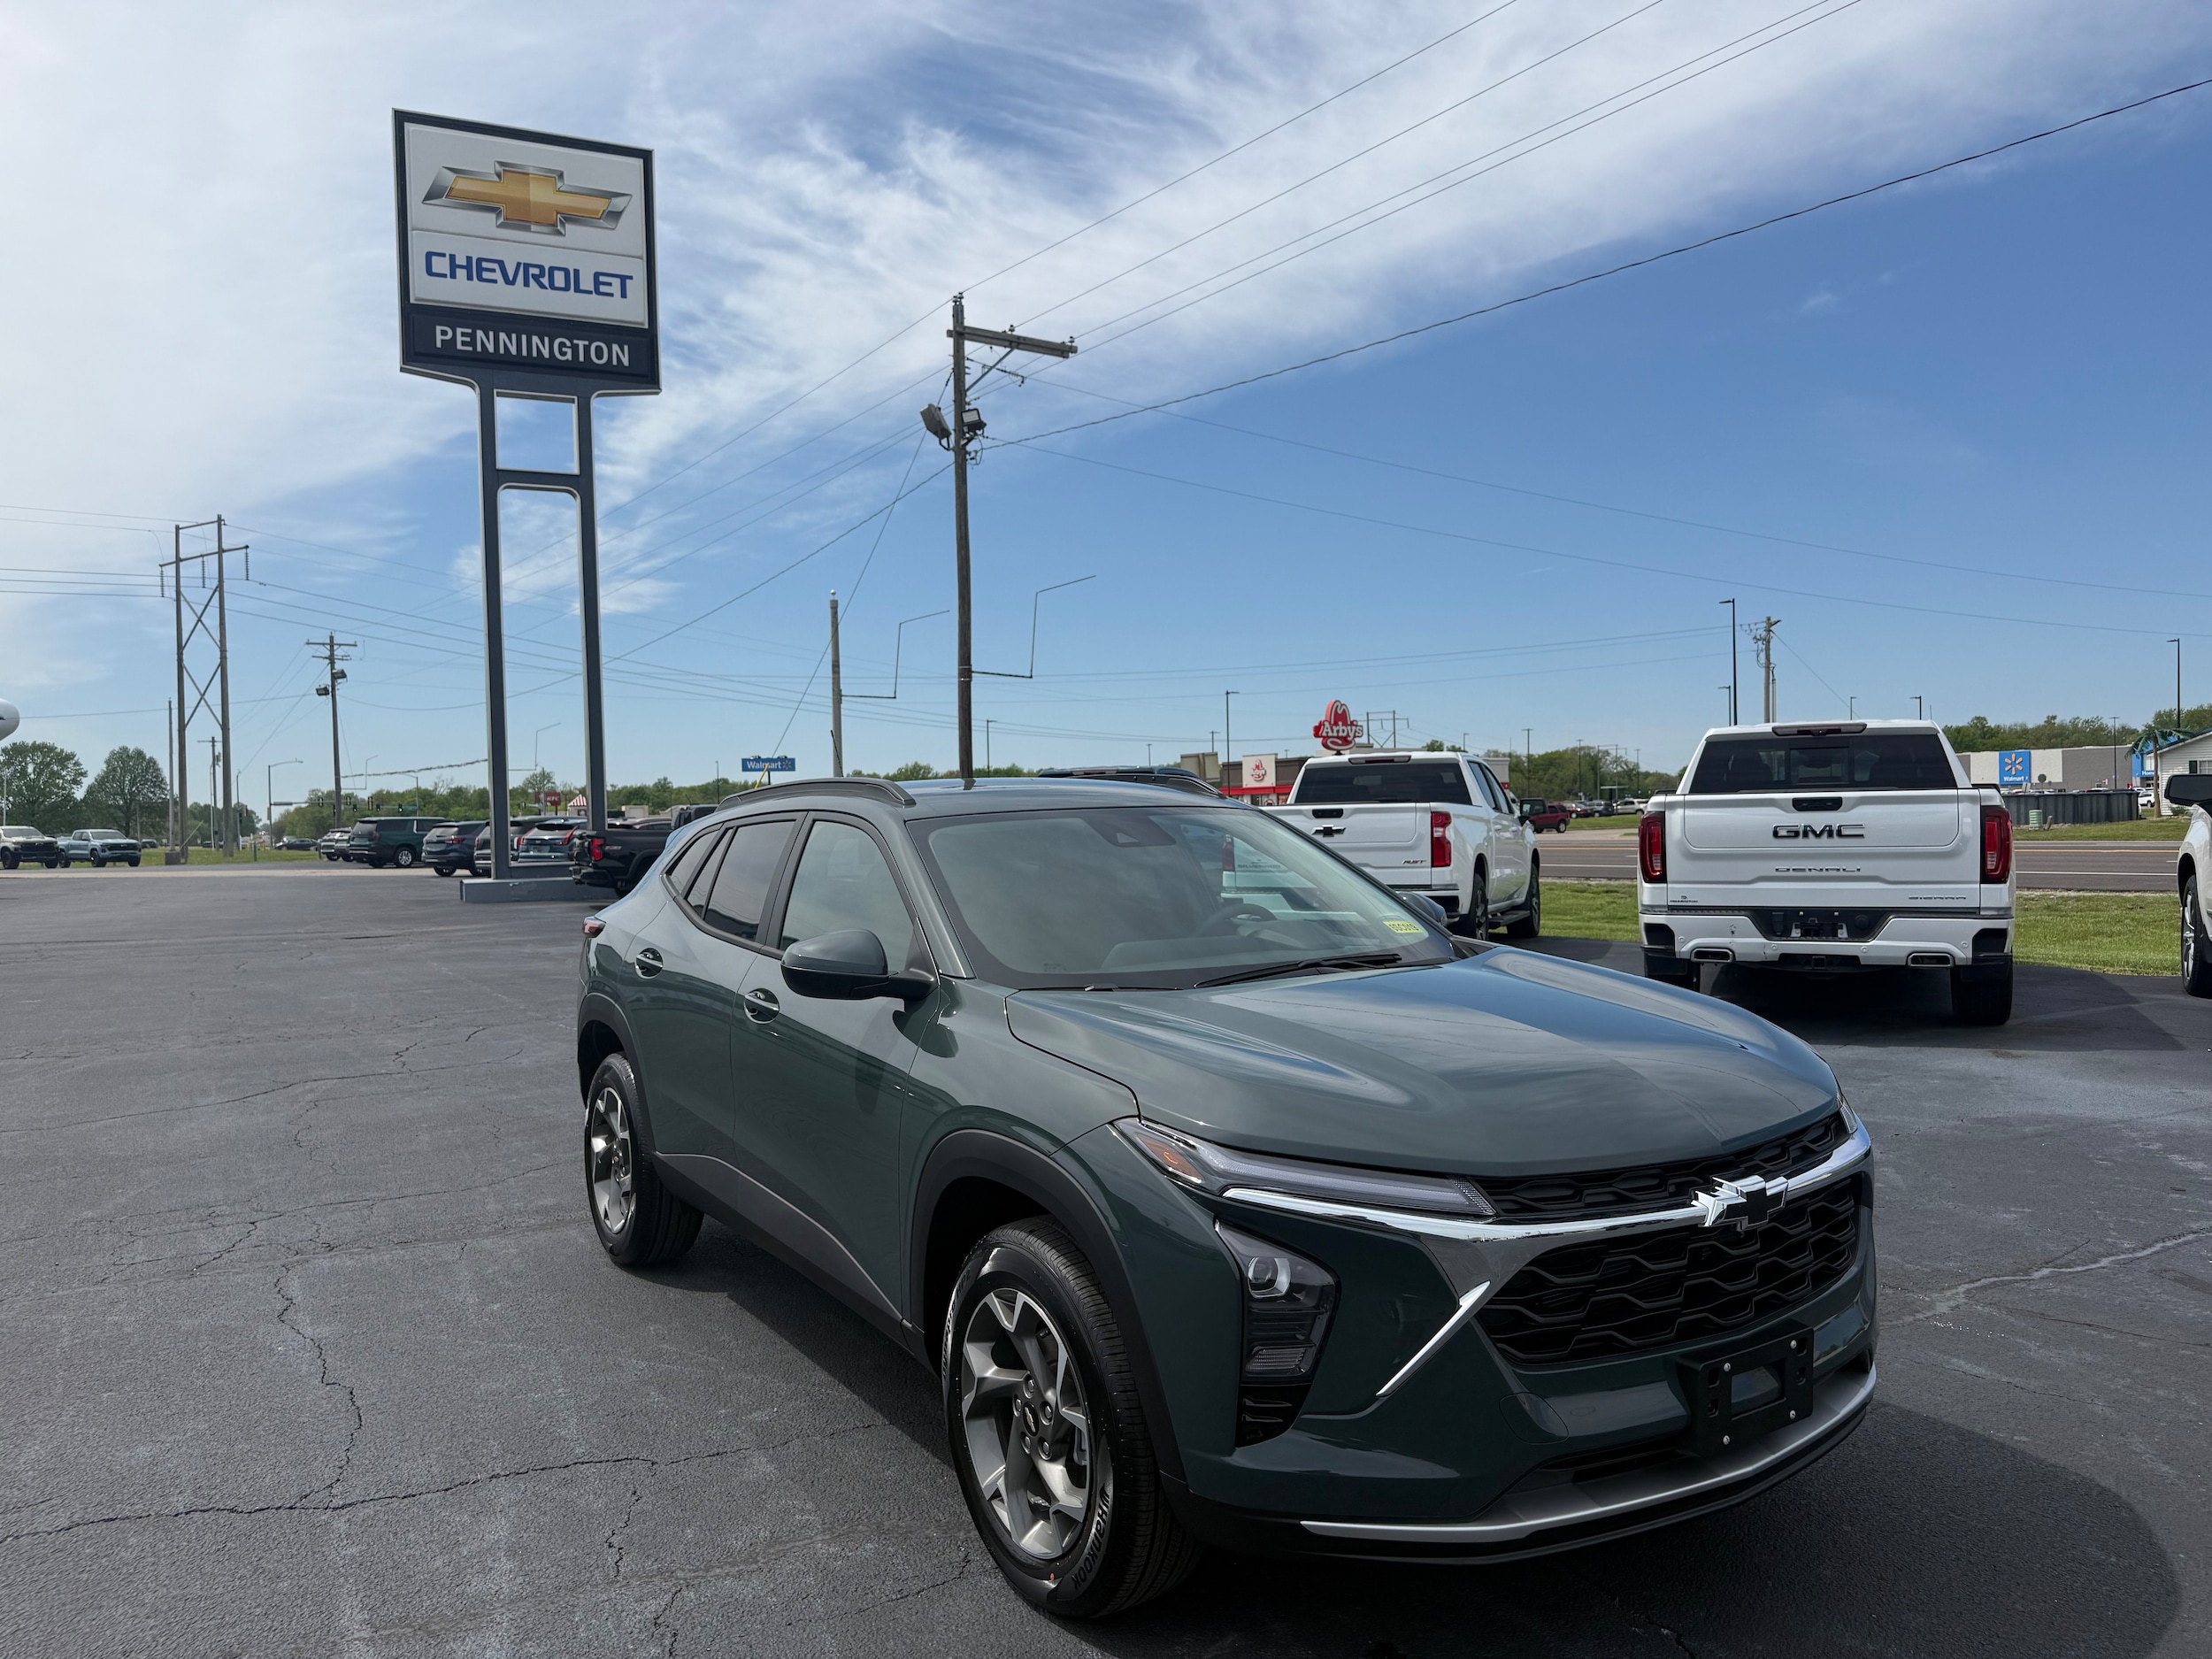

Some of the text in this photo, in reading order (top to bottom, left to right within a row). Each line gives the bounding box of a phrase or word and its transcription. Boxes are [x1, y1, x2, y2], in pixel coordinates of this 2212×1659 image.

[425, 250, 634, 299] CHEVROLET
[435, 325, 630, 366] PENNINGTON
[1321, 719, 1363, 741] Arby's
[1772, 823, 1865, 840] GMC
